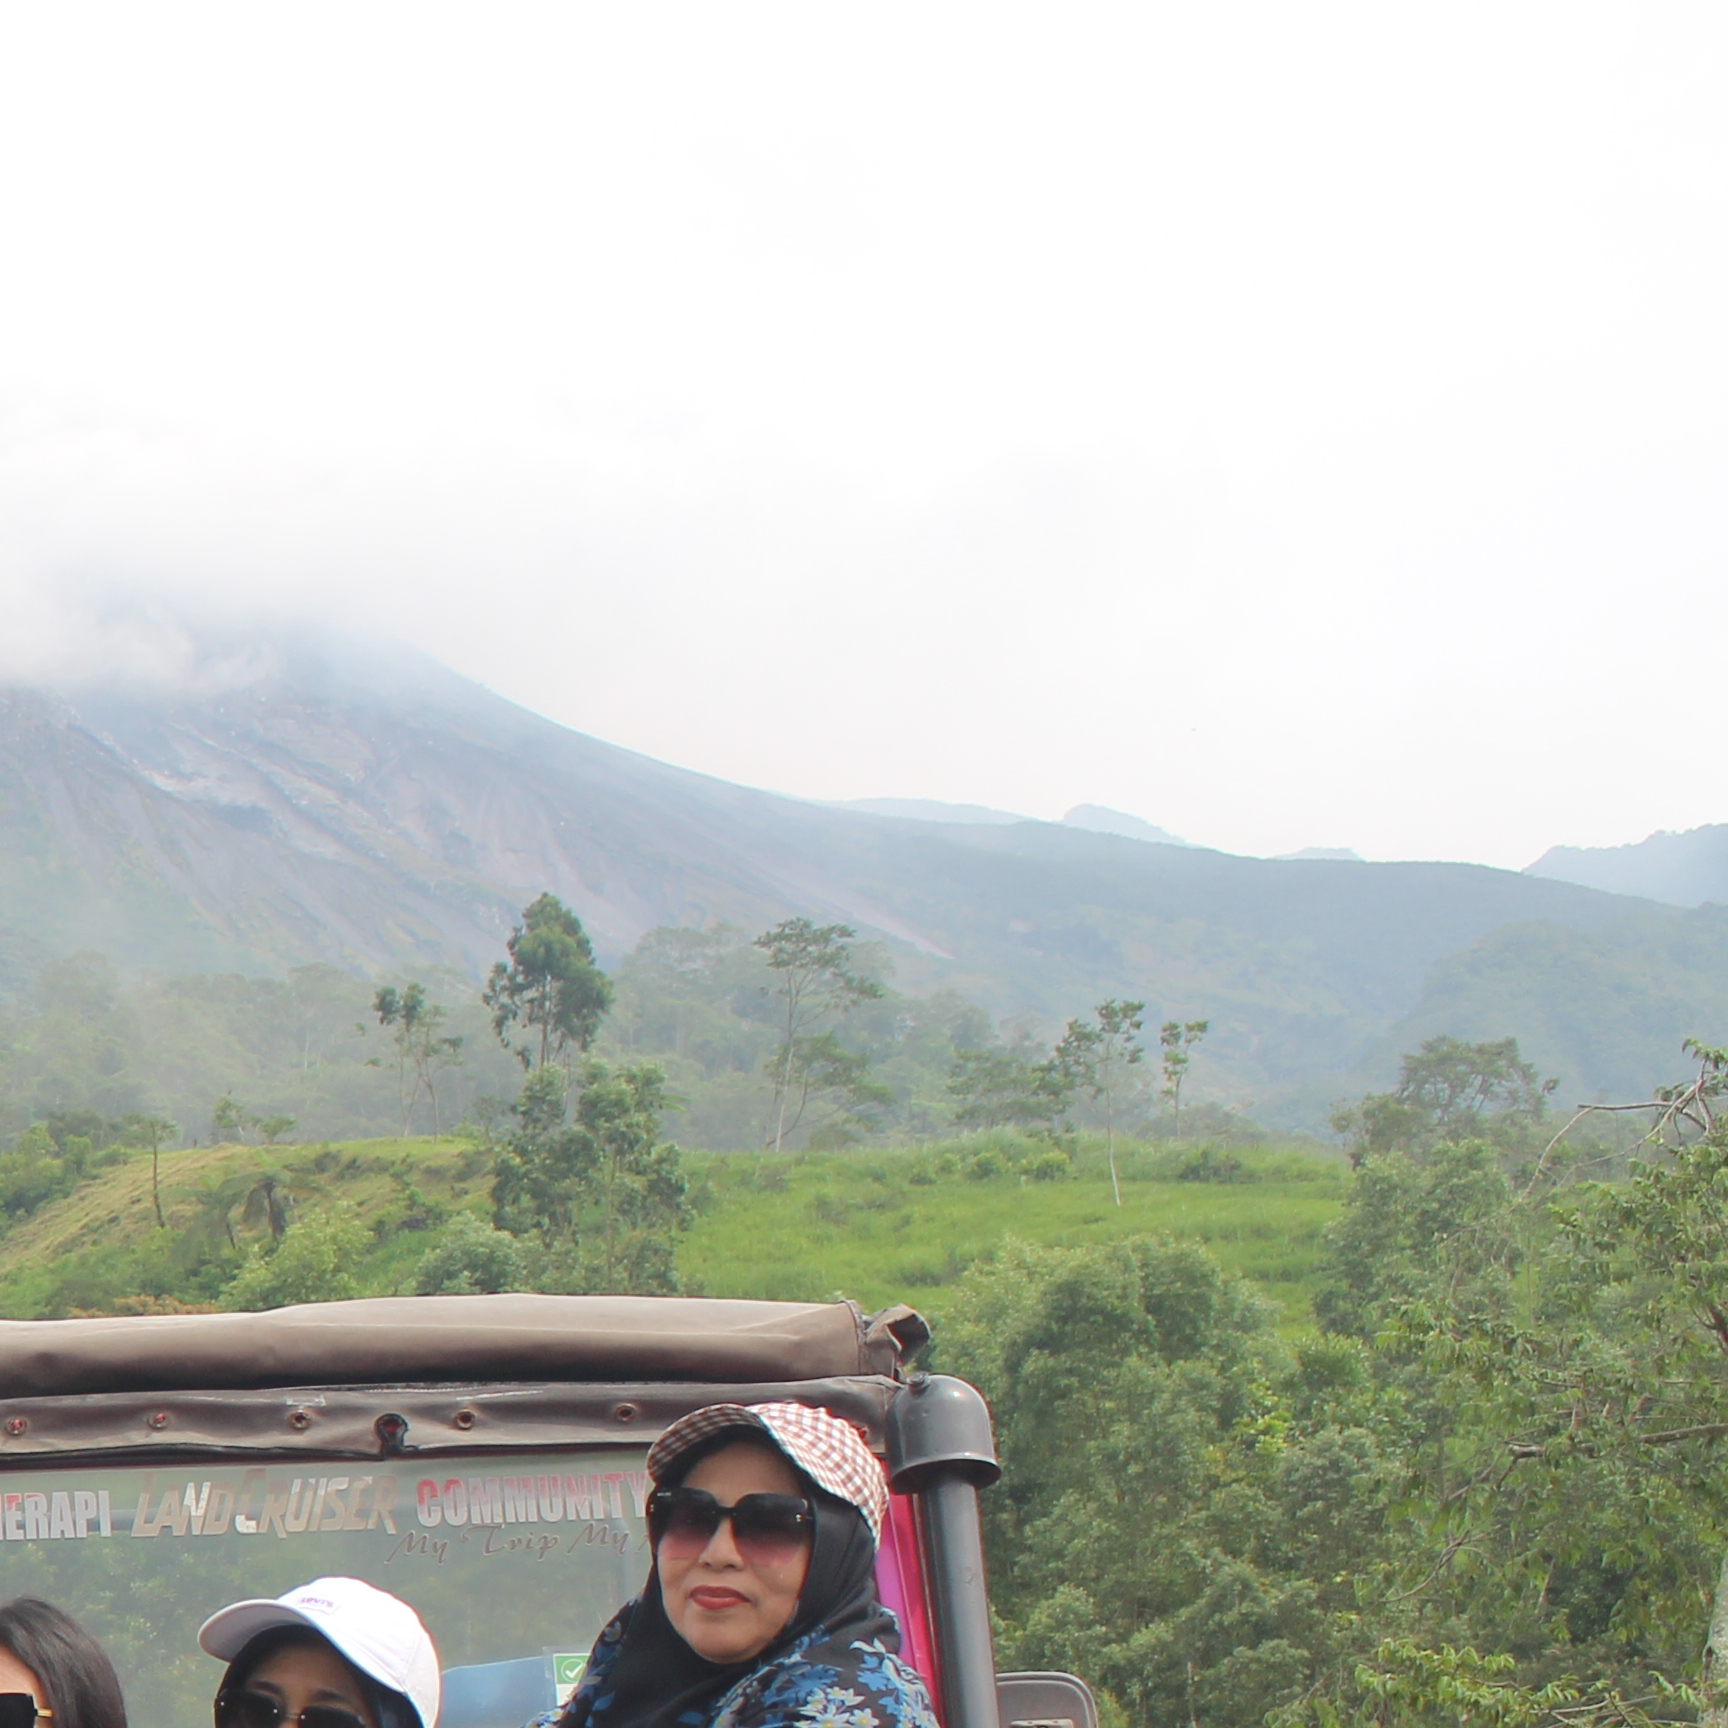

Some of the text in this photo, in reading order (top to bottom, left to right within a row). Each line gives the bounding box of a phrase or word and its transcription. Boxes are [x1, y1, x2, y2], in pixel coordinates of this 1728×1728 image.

[416, 1471, 647, 1528] COMMUNITY
[383, 1530, 448, 1565] My
[461, 1523, 559, 1561] Trip
[566, 1522, 630, 1555] My
